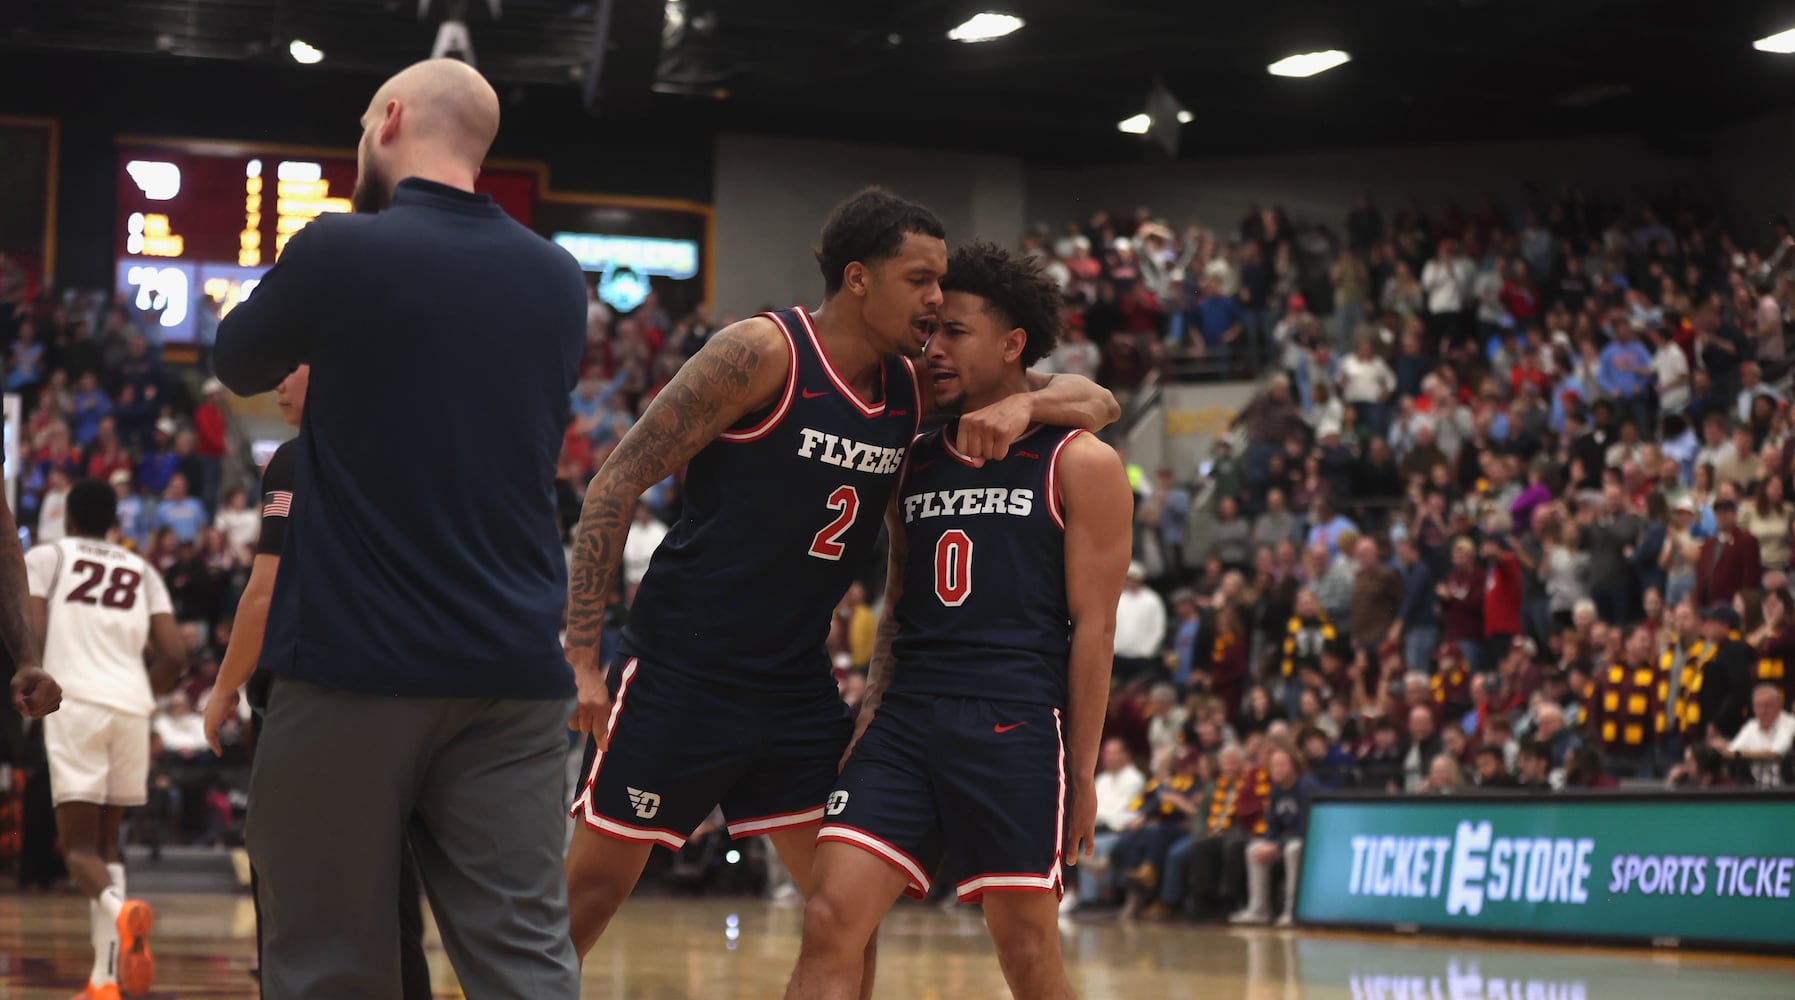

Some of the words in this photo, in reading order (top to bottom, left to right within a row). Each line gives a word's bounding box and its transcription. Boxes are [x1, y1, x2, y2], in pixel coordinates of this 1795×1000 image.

[797, 427, 905, 475] FLYERS
[808, 484, 860, 561] 2
[904, 487, 1034, 524] FLYERS
[66, 559, 142, 610] 28
[934, 529, 973, 607] 0
[1349, 836, 1451, 898] TICKET
[1487, 837, 1594, 904] STORE
[1608, 855, 1708, 895] SPORTS
[1716, 857, 1793, 898] TICKE
